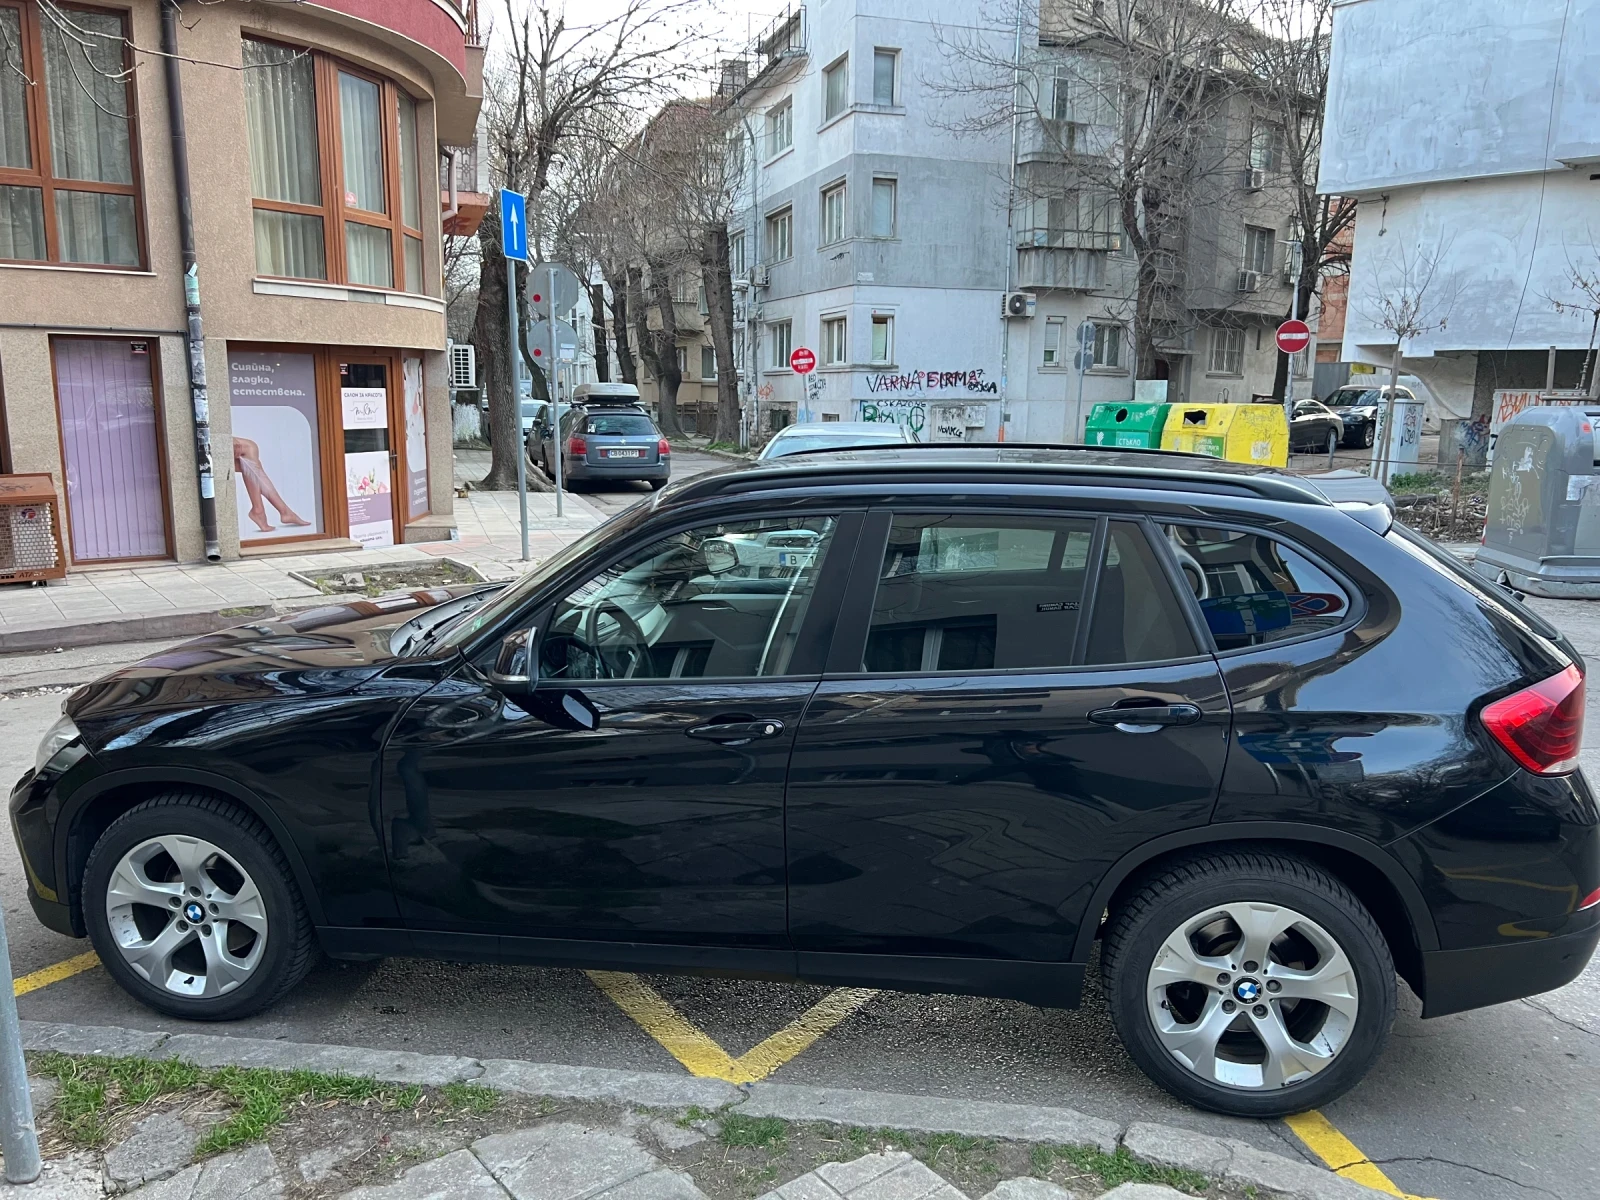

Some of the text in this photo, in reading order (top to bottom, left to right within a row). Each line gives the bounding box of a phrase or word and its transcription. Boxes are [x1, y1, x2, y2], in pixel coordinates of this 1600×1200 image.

[231, 362, 275, 373] Сияйна,
[232, 375, 274, 385] гладка,
[866, 369, 922, 392] VARNA
[232, 387, 306, 397] естествена.
[1118, 438, 1141, 446] СТЪКЛО
[790, 555, 797, 565] B
